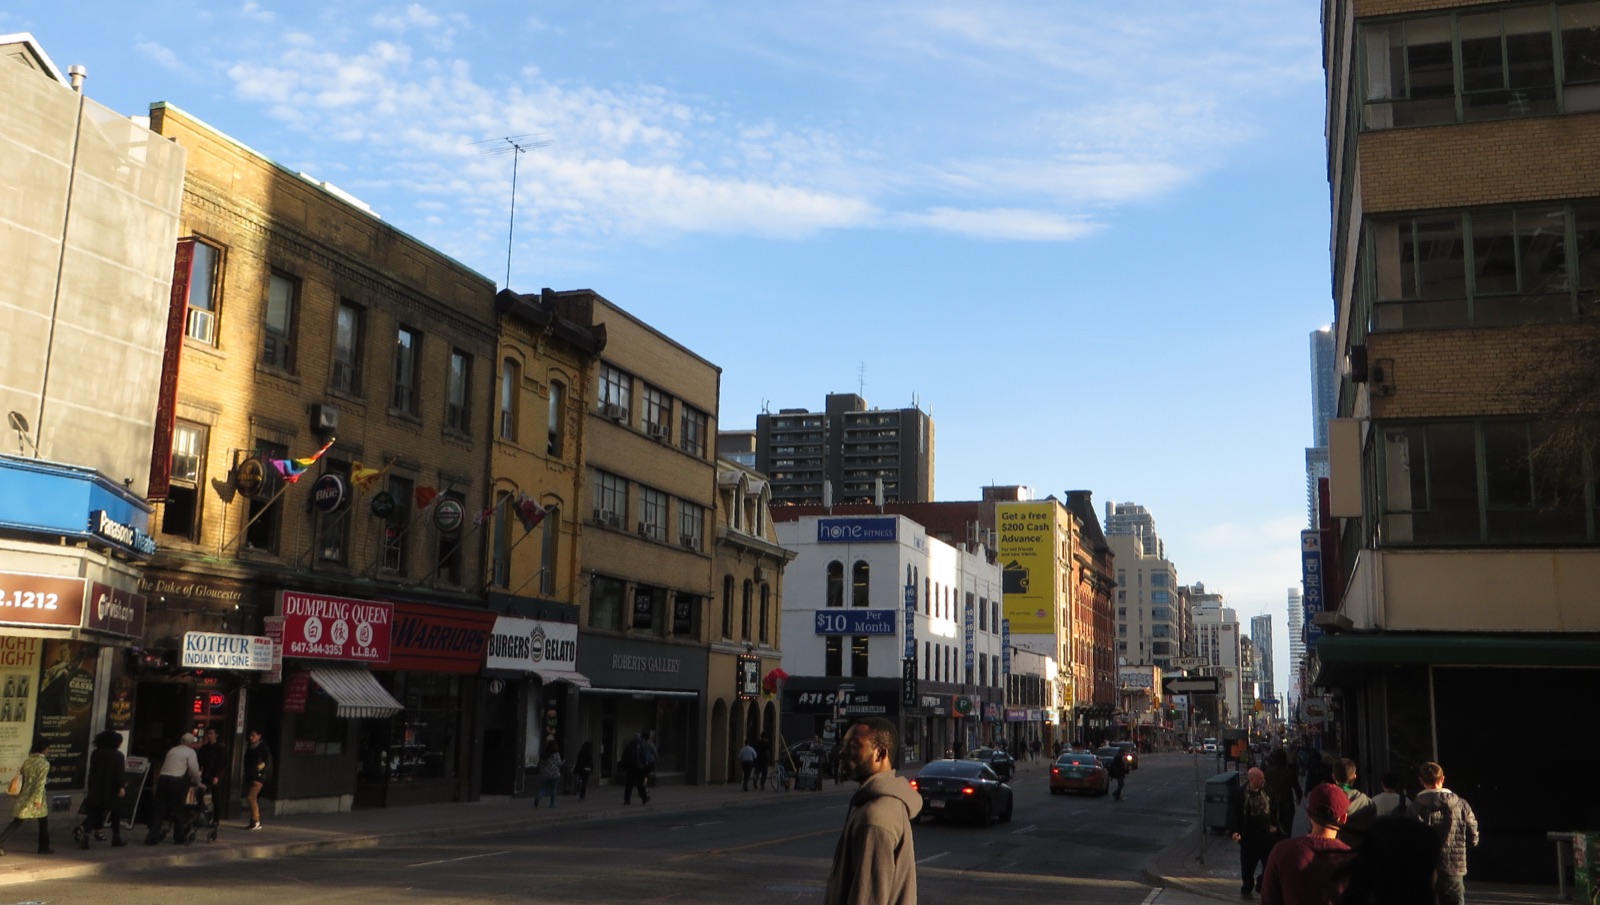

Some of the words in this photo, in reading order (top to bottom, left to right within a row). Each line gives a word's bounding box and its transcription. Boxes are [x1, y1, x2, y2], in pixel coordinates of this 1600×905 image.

[316, 488, 338, 502] Blue
[1001, 511, 1018, 520] Get
[1028, 511, 1047, 520] free
[99, 510, 134, 546] Panasonic
[820, 523, 862, 538] hone
[863, 529, 894, 538] FITNESS
[1001, 523, 1024, 533] $200
[1026, 522, 1049, 531] Cash
[156, 580, 181, 595] Duke
[183, 583, 194, 598] of
[195, 585, 243, 601] Gloucester
[286, 596, 349, 621] DUMPLING
[352, 605, 389, 625] QUEEN
[817, 613, 847, 632] $10
[866, 611, 882, 621] Per
[854, 621, 891, 632] Month
[397, 617, 486, 652] WARRIORS
[186, 634, 250, 655] KOTHUR
[291, 641, 343, 656] 647-344-3353
[352, 646, 379, 658] L.L.B.O.
[488, 633, 530, 659] BURGERS
[544, 640, 576, 662] GELATO
[185, 653, 215, 665] INDIAN
[217, 655, 250, 667] CUISINE
[612, 655, 647, 671] ROBERTS
[648, 657, 681, 674] GALLERY
[798, 692, 823, 705] AJI
